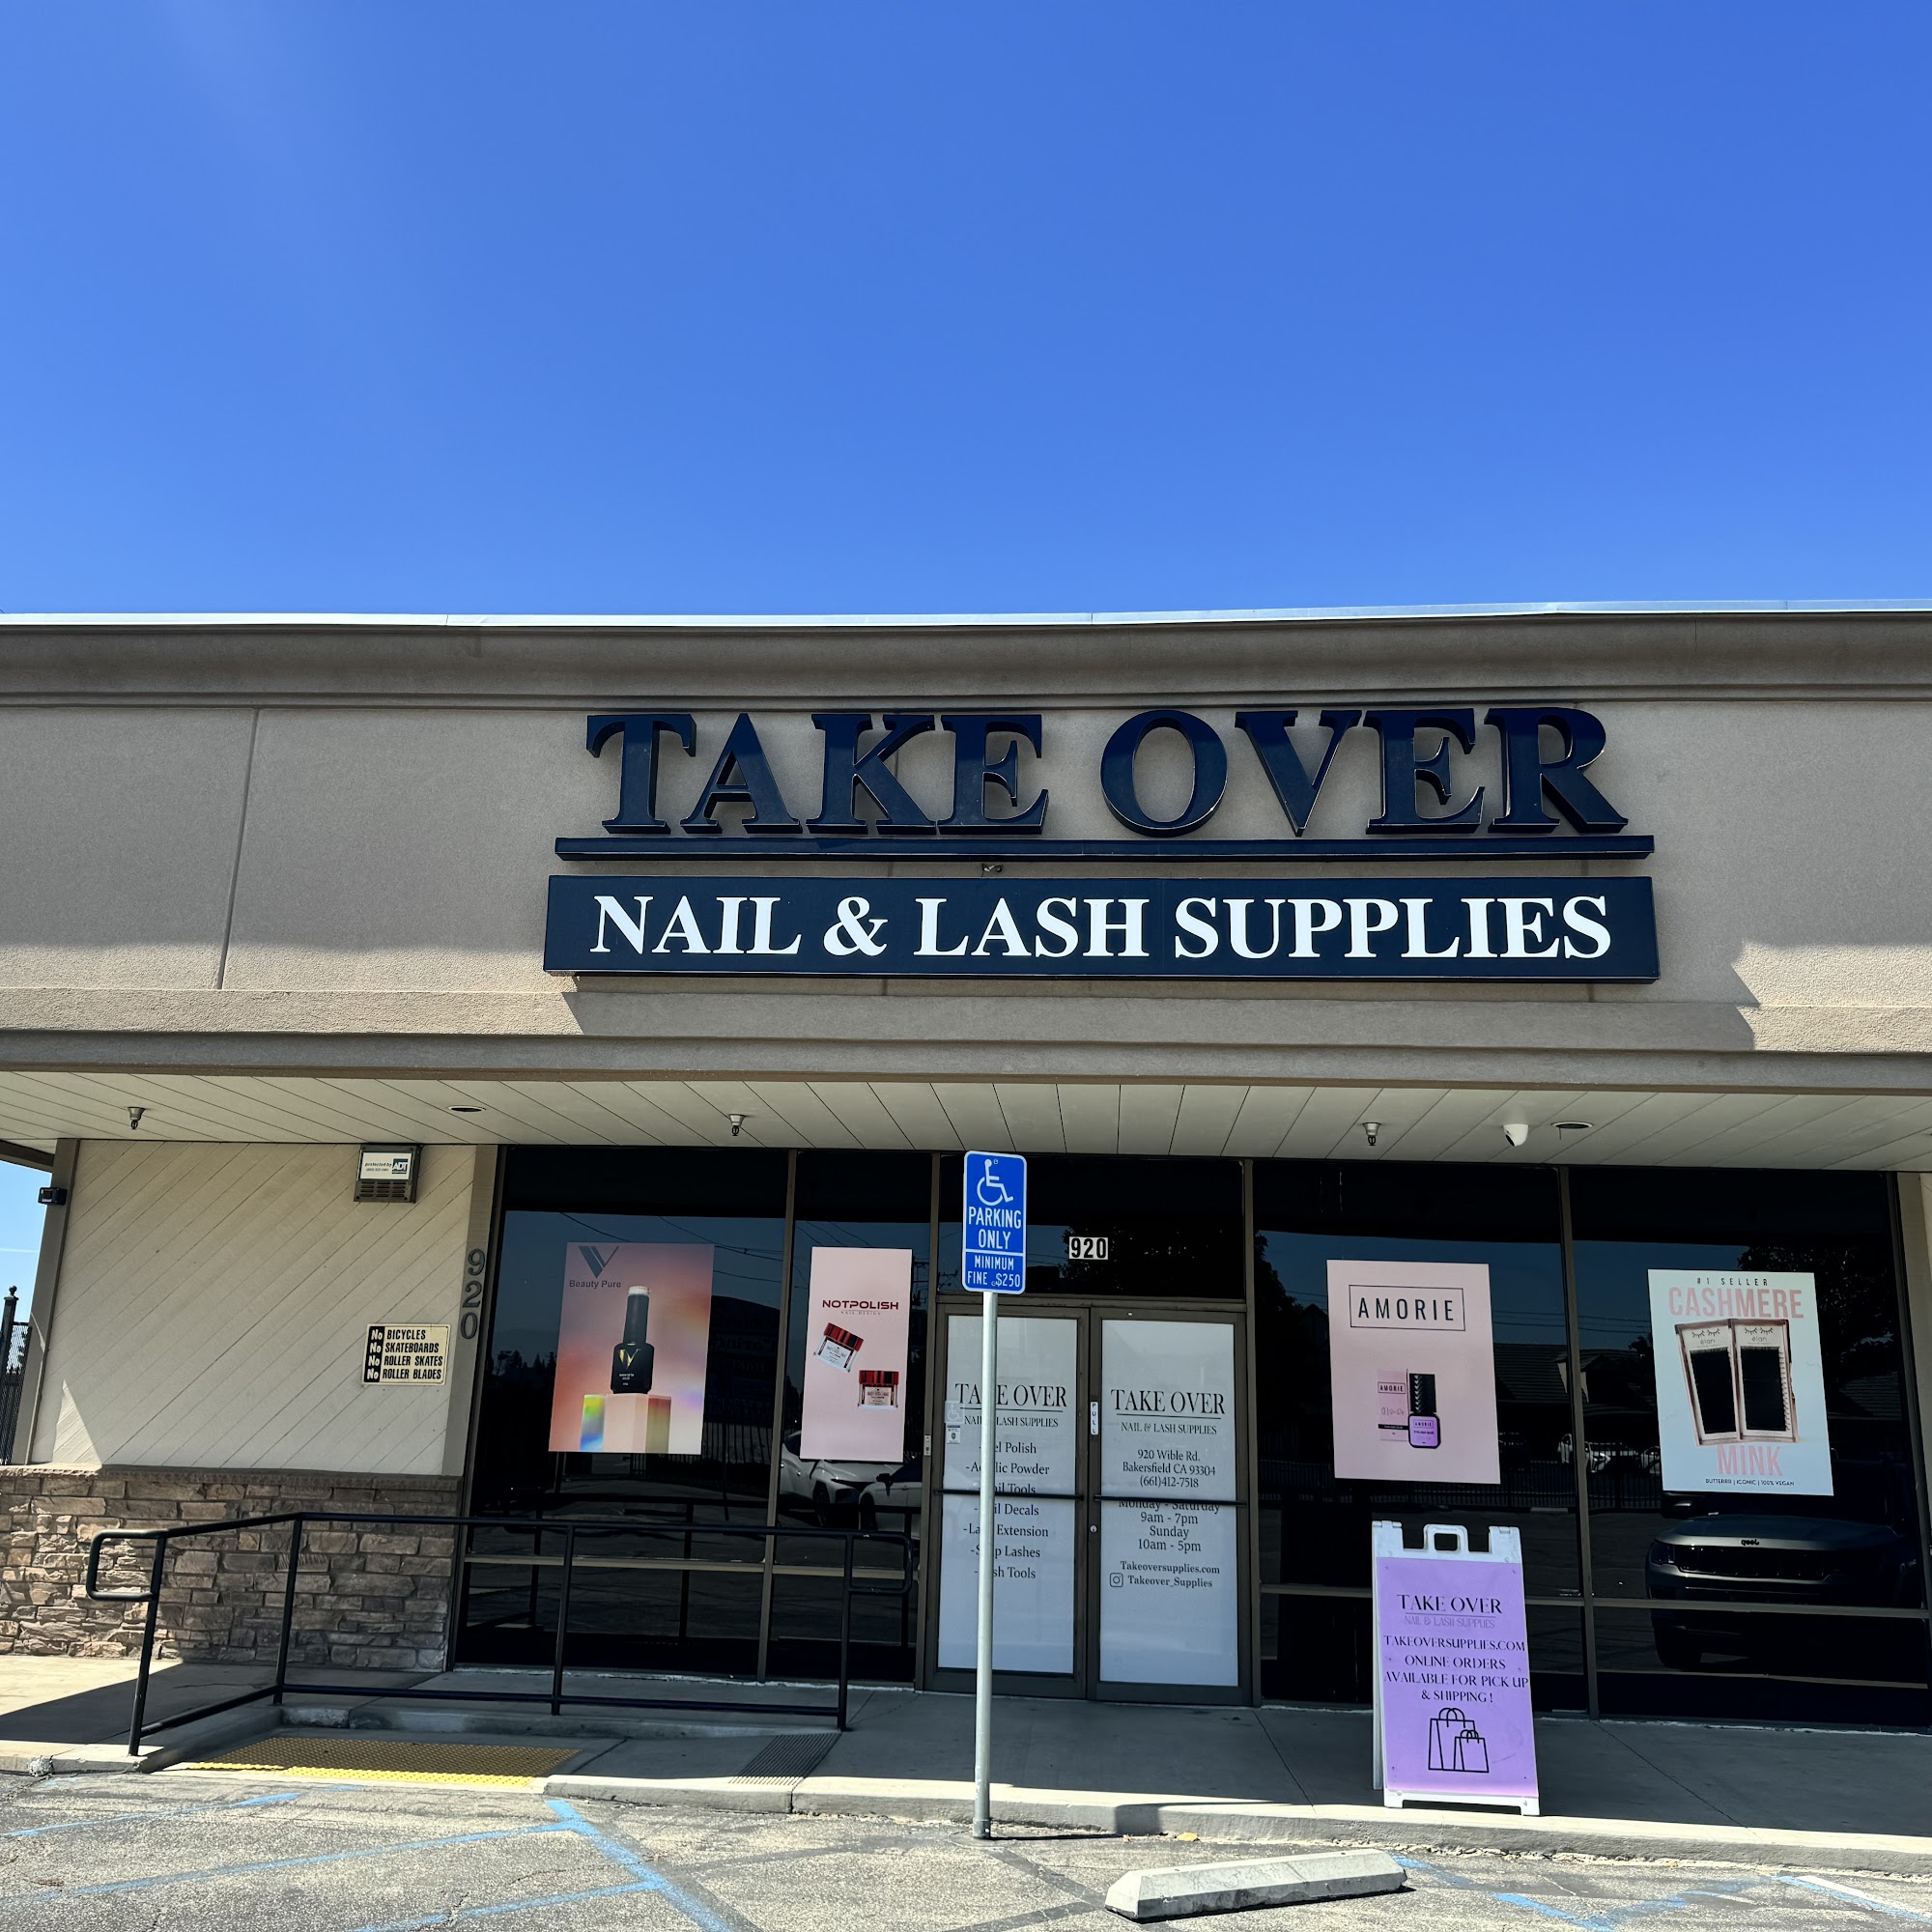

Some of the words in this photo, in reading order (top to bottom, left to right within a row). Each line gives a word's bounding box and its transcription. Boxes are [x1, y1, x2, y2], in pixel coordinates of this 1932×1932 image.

[585, 713, 1049, 835] TAKE
[1100, 707, 1628, 838] OVER
[590, 895, 802, 955] NAIL
[823, 896, 888, 957] &
[914, 895, 1151, 958] LASH
[1175, 895, 1611, 959] SUPPLIES
[393, 1161, 408, 1170] ADT
[968, 1207, 1022, 1229] PARKING
[978, 1229, 1011, 1250] ONLY
[1071, 1237, 1107, 1259] 920
[974, 1255, 1014, 1271] MINIMUM
[569, 1280, 599, 1290] Beauty
[967, 1271, 988, 1285] FINE
[995, 1272, 1021, 1287] $250
[1720, 1278, 1768, 1286] SELLER
[460, 1248, 486, 1340] 920
[823, 1300, 899, 1310] NOTPOLISH
[1358, 1297, 1454, 1321] AMORIE
[1668, 1287, 1804, 1319] CASHMERE
[371, 1329, 383, 1340] No
[387, 1329, 426, 1340] BICYCLES
[369, 1342, 382, 1353] No
[385, 1343, 439, 1353] SKATEBOARDS
[368, 1355, 380, 1366] No
[384, 1355, 411, 1366] ROLLER
[414, 1356, 443, 1366] SKATES
[367, 1368, 379, 1379] No
[382, 1368, 410, 1379] ROLLER
[413, 1369, 441, 1379] BLADES
[955, 1383, 1008, 1405] TAE
[1013, 1384, 1067, 1407] OVER
[1110, 1389, 1165, 1412] TAKE
[1170, 1391, 1225, 1414] OVER
[964, 1415, 982, 1425] NAI
[996, 1417, 1018, 1427] LASH
[1020, 1418, 1058, 1428] SUPPLIES
[1121, 1422, 1142, 1433] NAIL
[1144, 1422, 1151, 1433] &
[1153, 1423, 1176, 1434] LASH
[1178, 1424, 1217, 1435] SUPPLIES
[1005, 1441, 1037, 1454] Polish
[1137, 1449, 1155, 1460] 920
[1157, 1449, 1184, 1461] Wible
[1186, 1450, 1201, 1462] Rd.
[1717, 1444, 1783, 1476] MINK
[1010, 1463, 1050, 1475] Powder
[1123, 1461, 1171, 1474] Bakersfield
[1173, 1463, 1187, 1474] CA
[1189, 1465, 1216, 1476] 93304
[1140, 1475, 1199, 1488] (661)412-7518
[1008, 1483, 1036, 1494] Tools
[1005, 1503, 1039, 1516] Decals
[1119, 1501, 1161, 1512] Monday
[1172, 1503, 1220, 1514] Saturday
[1140, 1511, 1164, 1523] 9am
[1175, 1513, 1198, 1526] 7pm
[997, 1524, 1049, 1537] Extension
[1149, 1525, 1189, 1540] Sunday
[1005, 1545, 1040, 1558] Lashes
[1138, 1538, 1167, 1550] 10am
[1178, 1540, 1201, 1554] 5pm
[1008, 1566, 1036, 1579] Tools
[1121, 1561, 1220, 1574] Takeoversupplies.com
[1128, 1575, 1213, 1589] Takeover_Supplies
[1397, 1595, 1446, 1612] TAKE
[1450, 1596, 1503, 1614] OVER
[1404, 1615, 1421, 1626] NAIL
[1434, 1617, 1455, 1627] LASH
[1457, 1618, 1495, 1628] SUPPLIES
[1383, 1635, 1525, 1652] TAKEOVERSUPPLIES.COM
[1405, 1654, 1449, 1667] ONLINE
[1453, 1657, 1506, 1670] ORDERS
[1384, 1671, 1449, 1685] AVAILABLE
[1451, 1674, 1477, 1686] FOR
[1481, 1676, 1509, 1688] PICK
[1512, 1677, 1529, 1689] UP
[1421, 1690, 1431, 1701] &
[1434, 1690, 1487, 1703] SHIPPING
